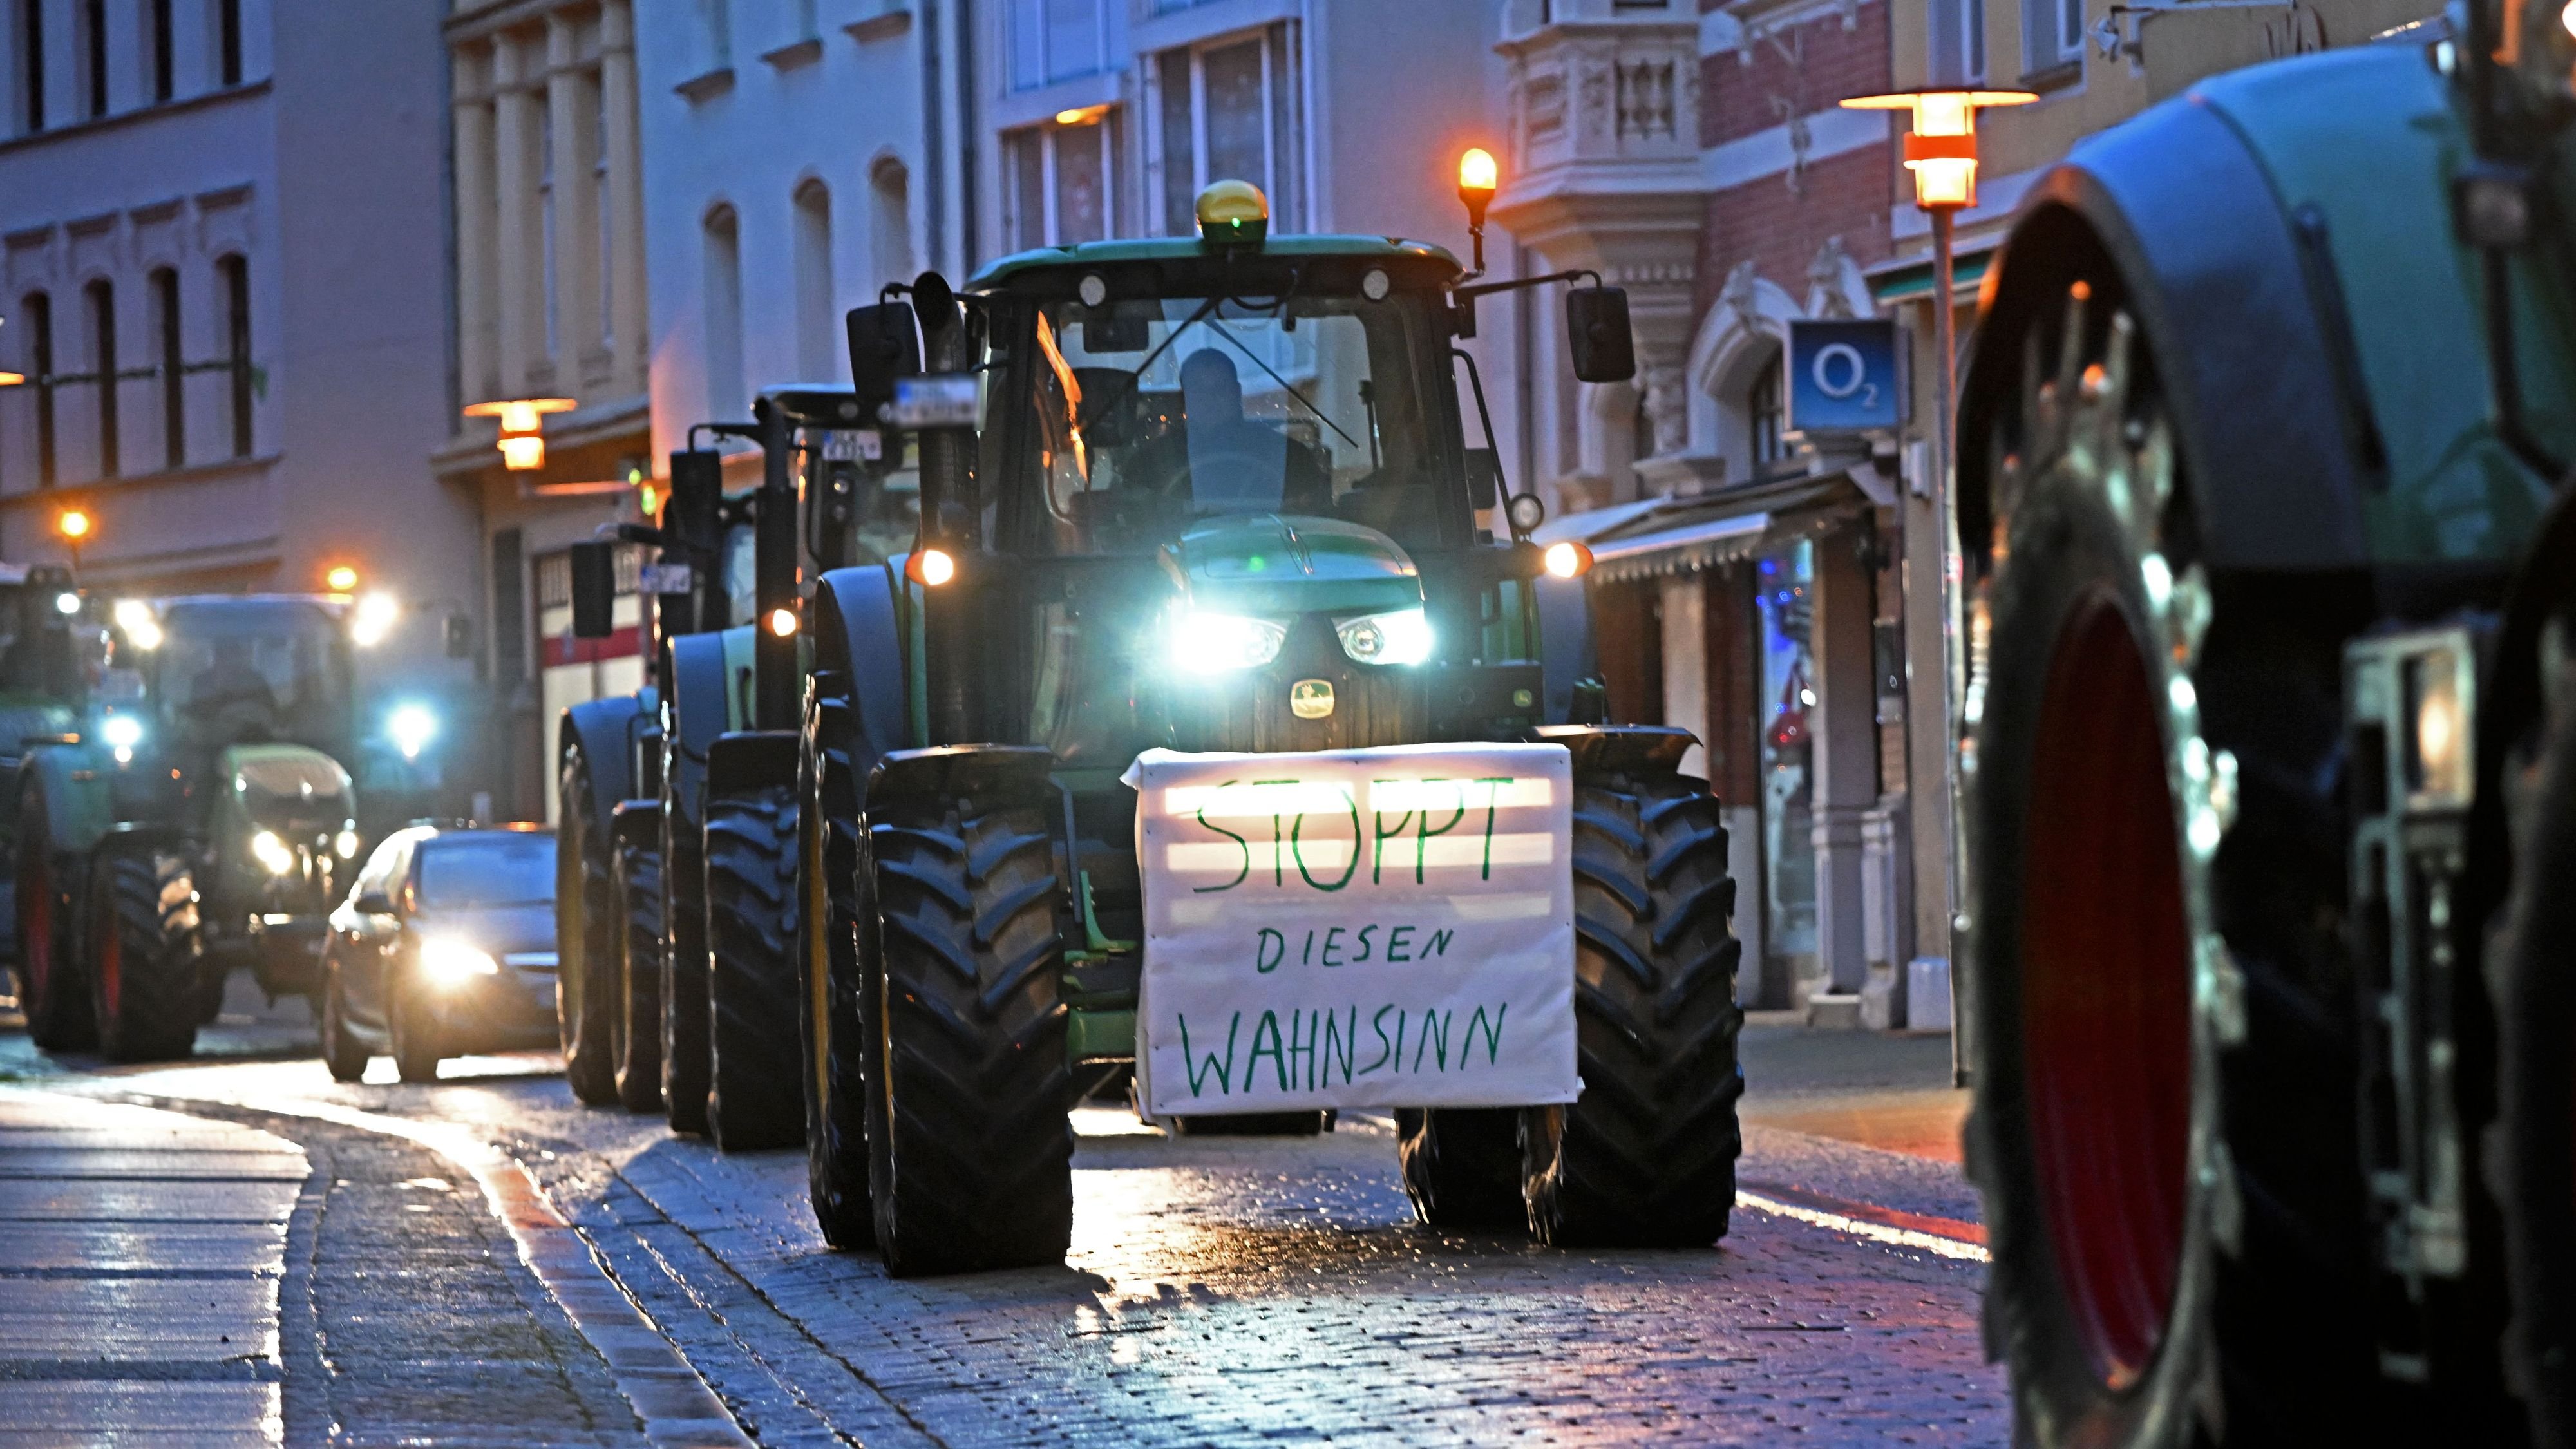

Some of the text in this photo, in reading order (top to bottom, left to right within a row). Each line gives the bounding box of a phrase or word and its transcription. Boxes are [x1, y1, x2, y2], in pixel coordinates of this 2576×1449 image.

[1193, 777, 1514, 893] STOPPT
[1257, 923, 1454, 974] DIESEN
[1178, 1001, 1508, 1098] WAHNSINN
